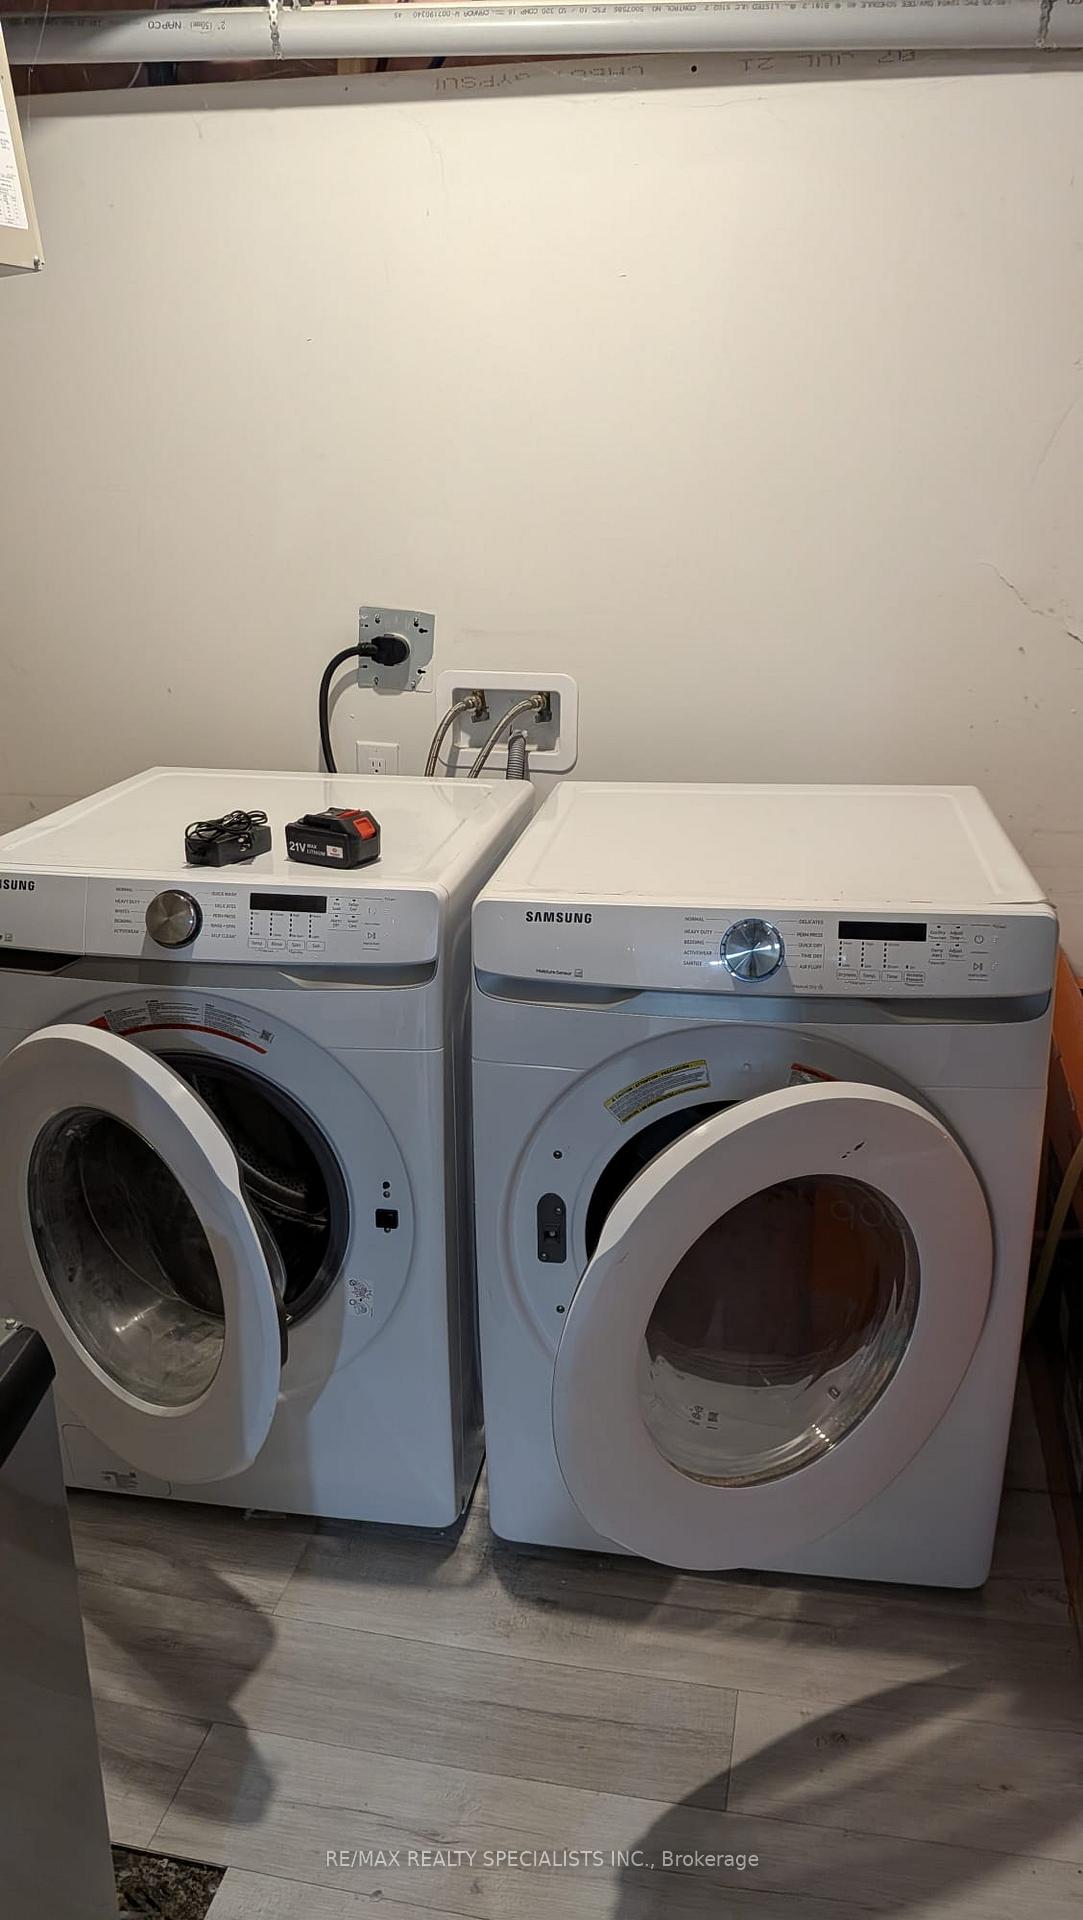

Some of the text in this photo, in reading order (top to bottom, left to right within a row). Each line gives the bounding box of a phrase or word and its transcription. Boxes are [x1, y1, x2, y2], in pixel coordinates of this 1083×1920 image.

[148, 21, 182, 30] NAPCO
[289, 841, 306, 853] 21V
[0, 879, 35, 891] SUNG
[525, 911, 593, 924] SAMSUNG
